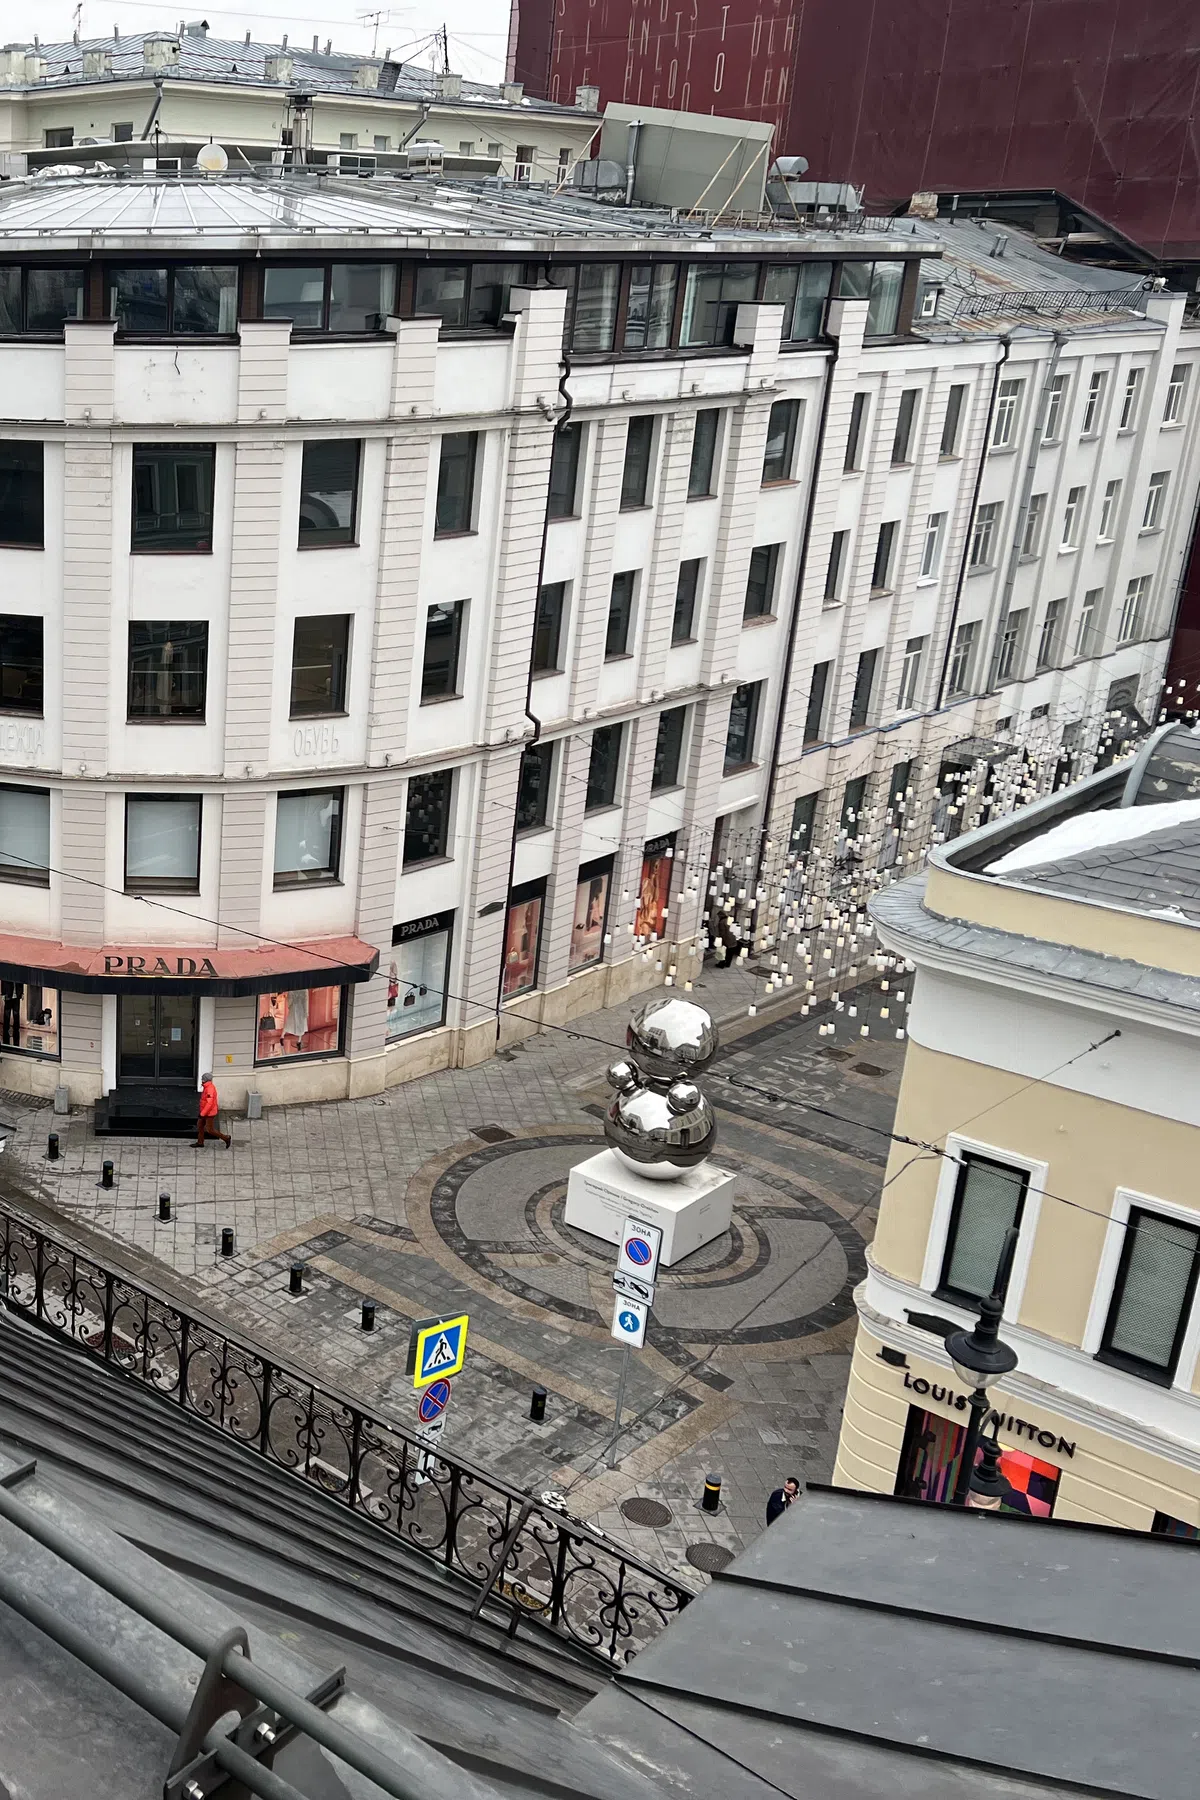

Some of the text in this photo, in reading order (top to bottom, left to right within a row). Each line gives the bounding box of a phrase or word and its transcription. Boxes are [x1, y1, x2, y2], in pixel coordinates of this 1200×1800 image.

[293, 724, 340, 758] ОБУВЬ
[400, 917, 440, 937] PRADA
[103, 956, 219, 977] PRADA
[631, 1224, 652, 1238] ЗОНА
[622, 1299, 641, 1312] ЗОНА
[903, 1372, 968, 1411] LOUIS
